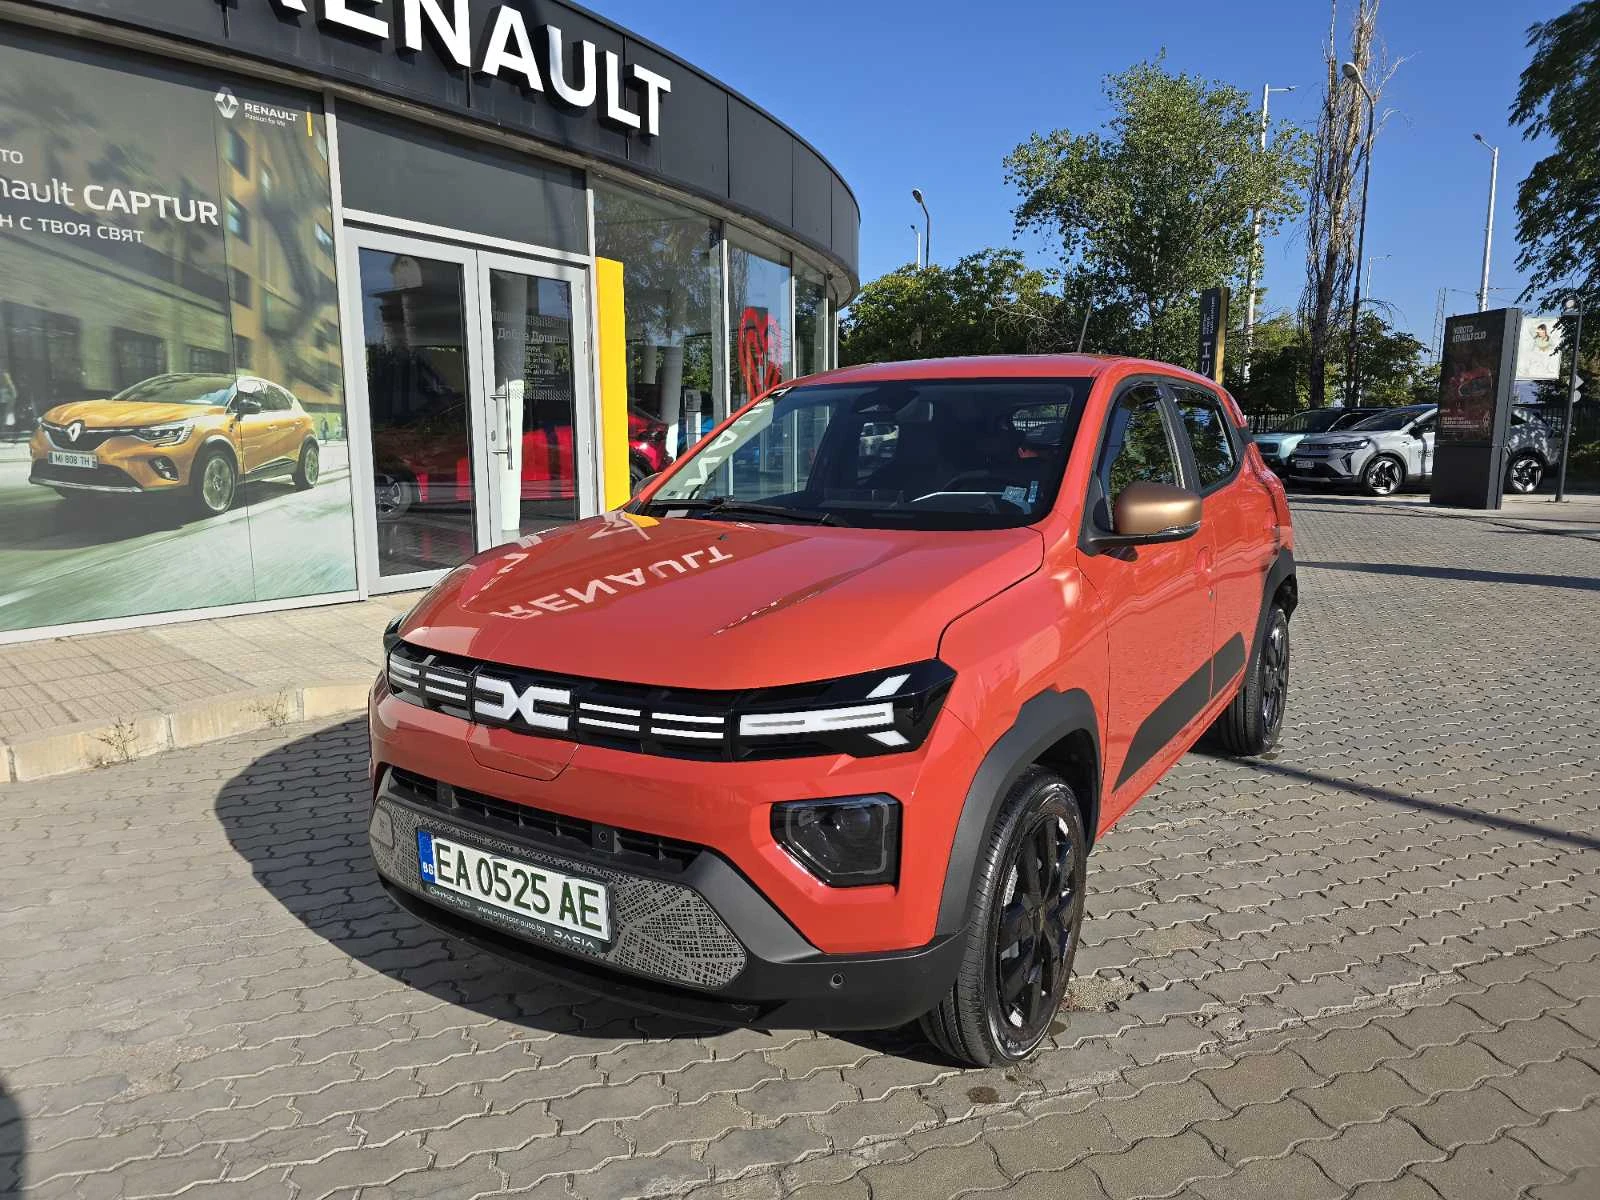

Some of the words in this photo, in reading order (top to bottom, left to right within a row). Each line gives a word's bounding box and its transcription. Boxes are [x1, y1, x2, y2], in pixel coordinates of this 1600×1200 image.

[271, 0, 671, 136] ENAULT
[244, 102, 298, 121] RENAULT
[83, 185, 219, 226] CAPTUR
[422, 862, 434, 875] BG
[435, 841, 472, 891] EA
[476, 857, 551, 915] 0525
[559, 880, 603, 932] AE
[553, 930, 595, 949] DACIA
